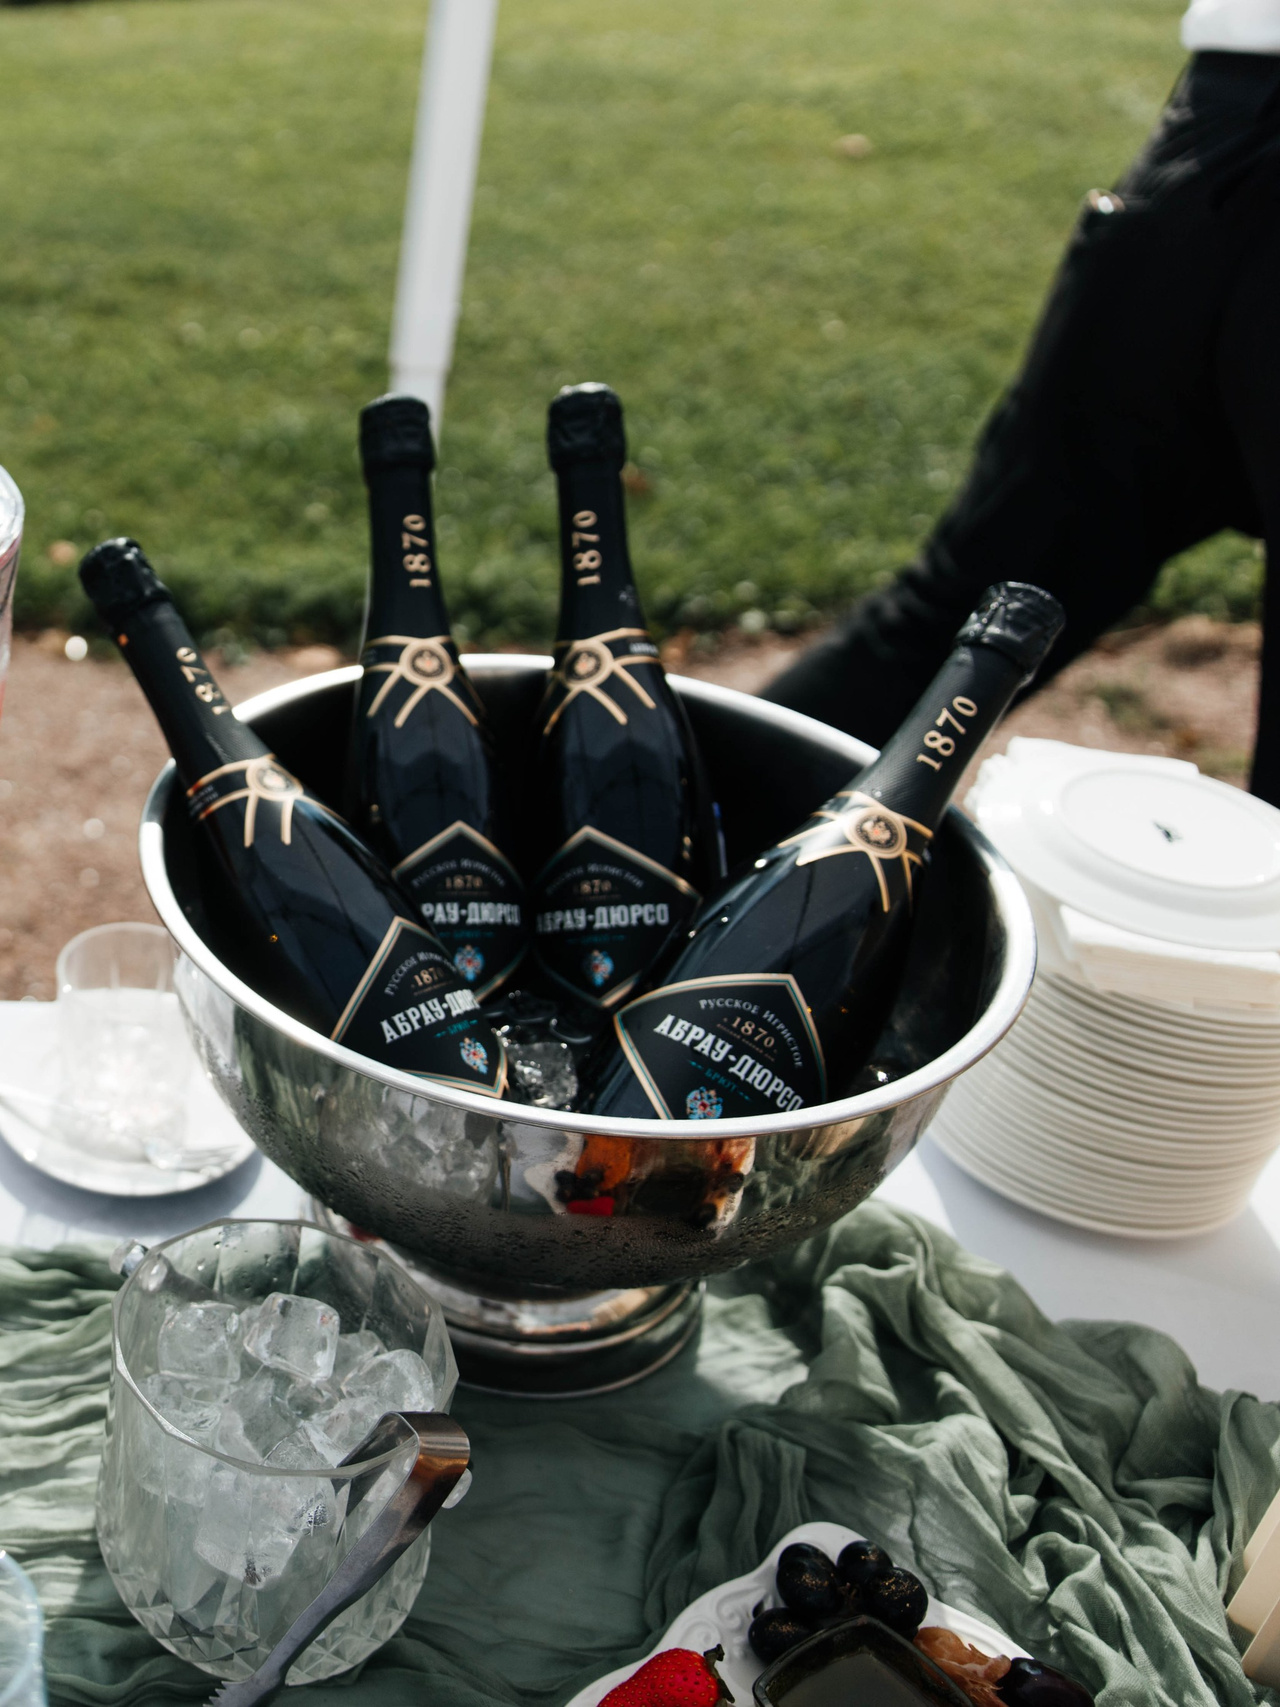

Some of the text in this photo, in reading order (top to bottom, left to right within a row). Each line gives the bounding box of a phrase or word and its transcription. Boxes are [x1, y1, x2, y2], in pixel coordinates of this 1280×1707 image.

[401, 514, 431, 587] 1870
[572, 510, 602, 586] 1870
[916, 696, 978, 772] 1870
[653, 1013, 805, 1112] АБРАУ-ДЮРСО
[699, 998, 760, 1014] РУССКОЕ
[762, 1010, 804, 1069] ИГРИСТОЕ
[732, 1016, 775, 1049] 1870
